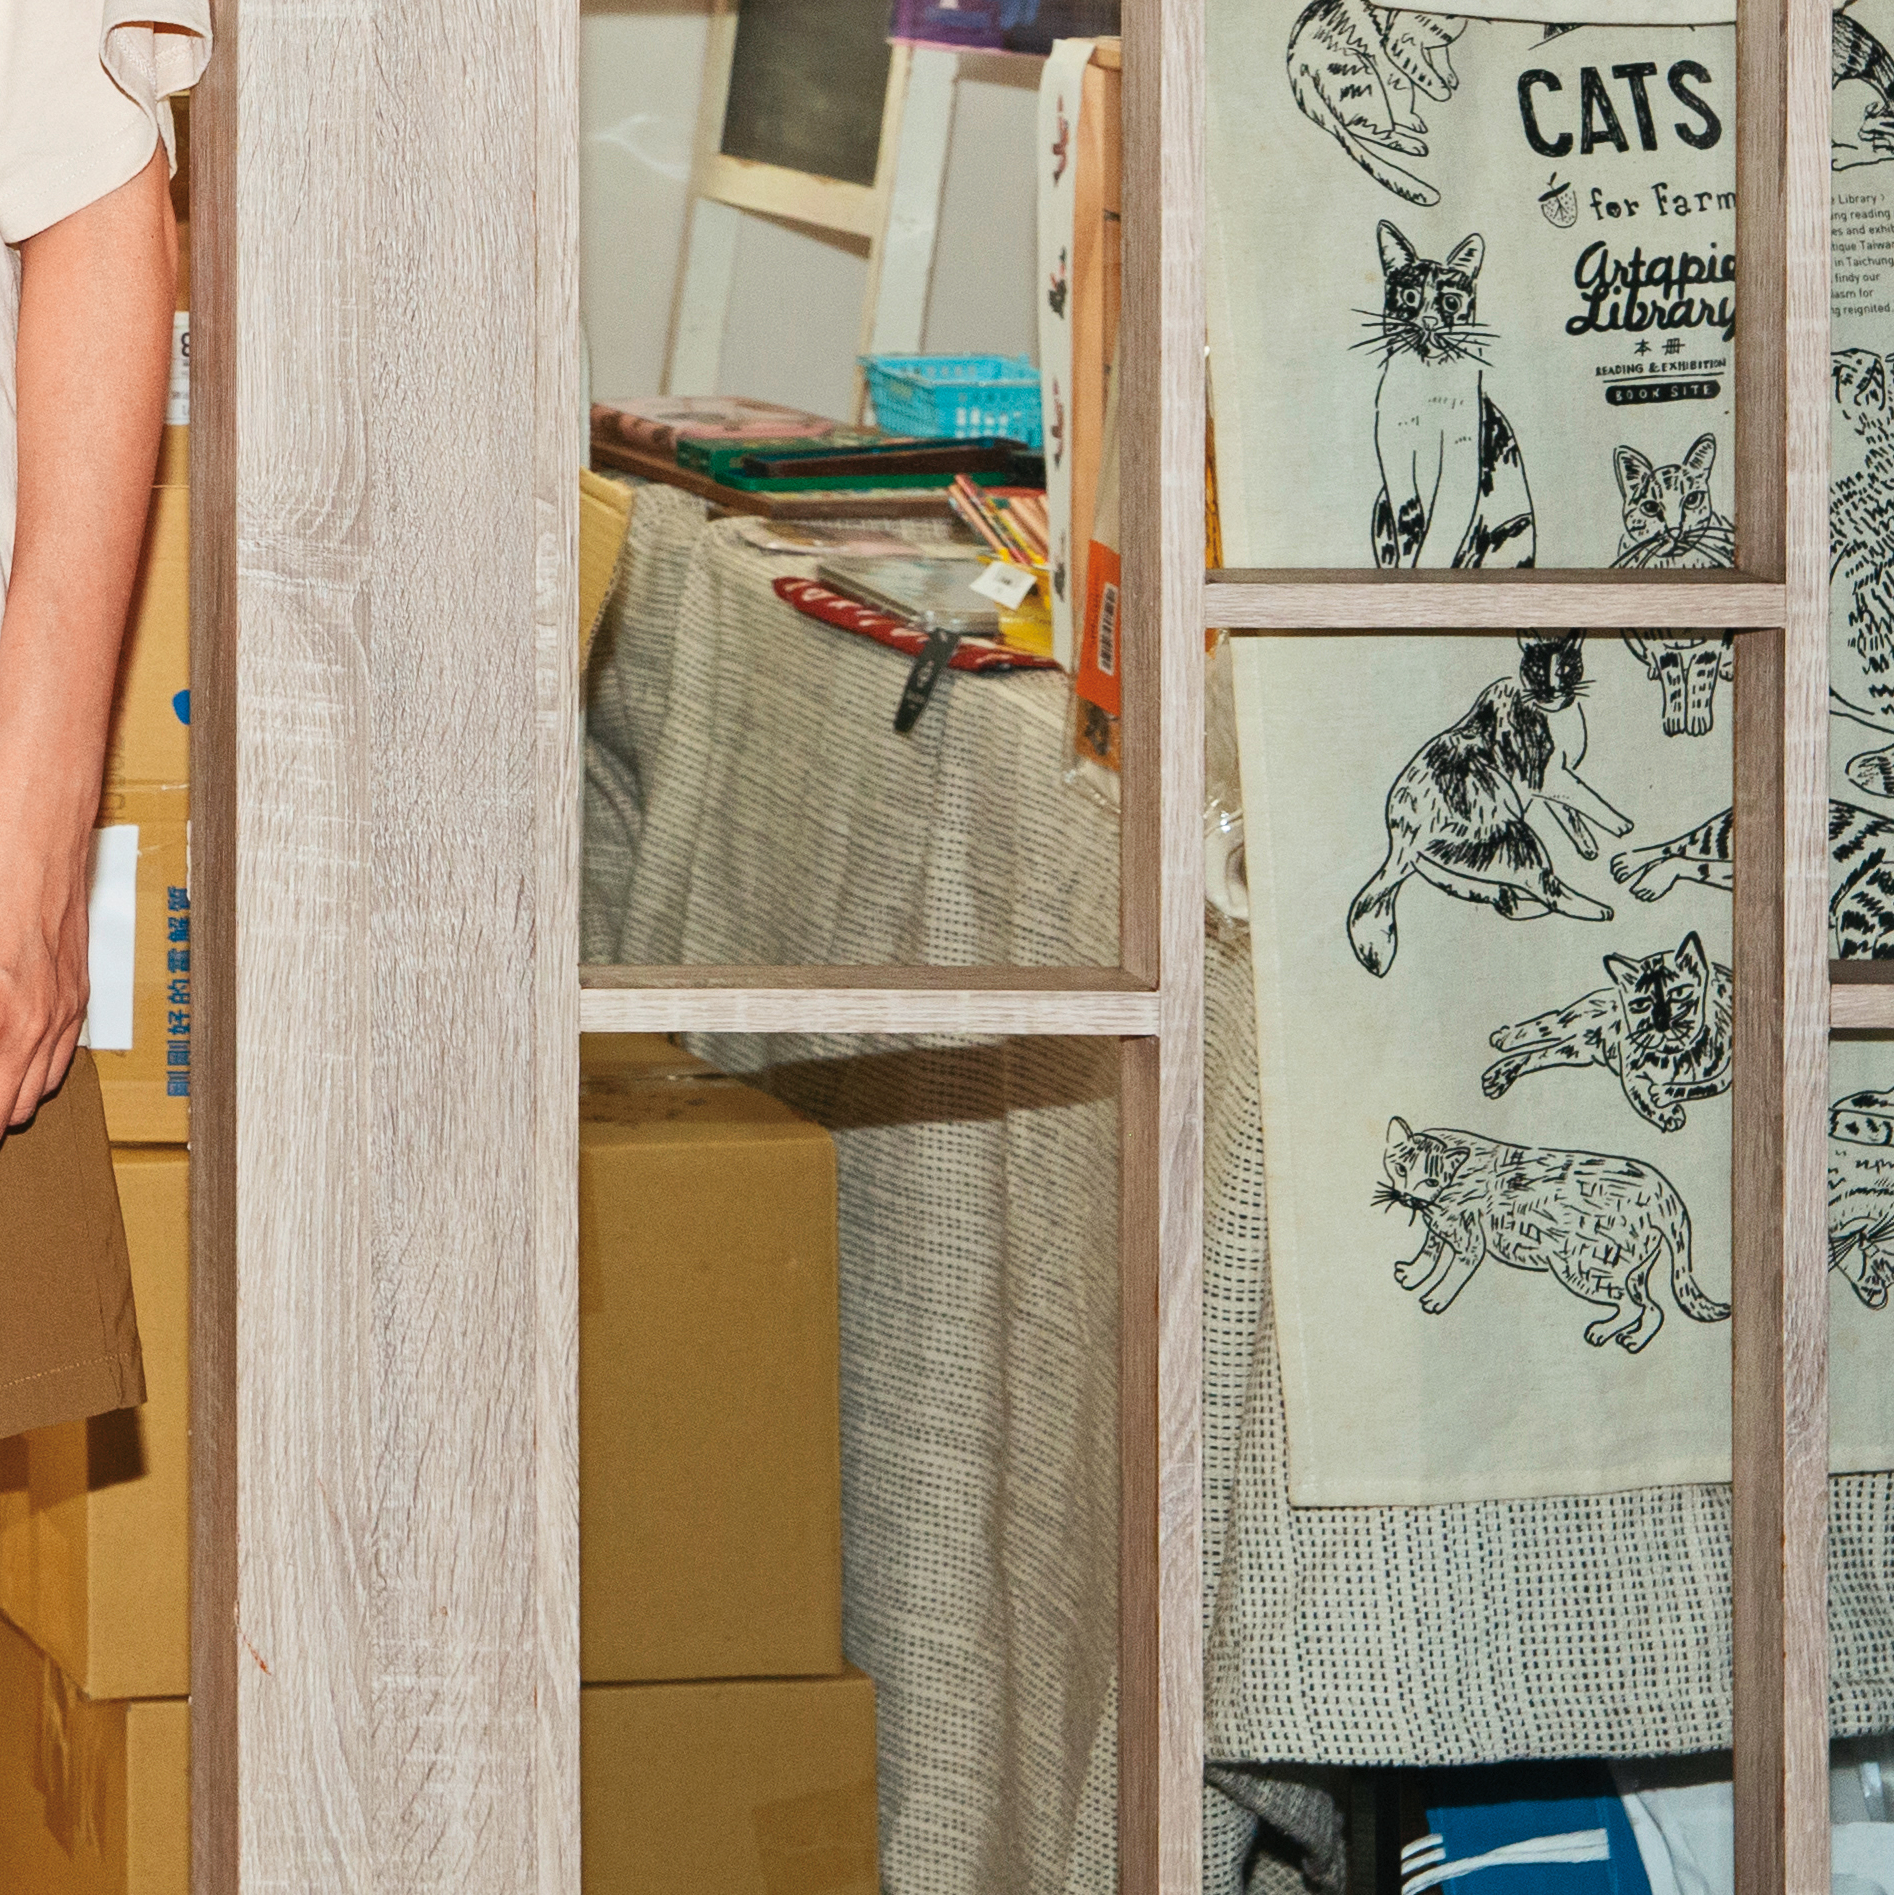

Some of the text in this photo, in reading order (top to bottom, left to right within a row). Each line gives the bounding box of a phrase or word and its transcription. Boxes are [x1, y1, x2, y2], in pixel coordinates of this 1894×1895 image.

[1517, 59, 1723, 158] CATS
[1589, 187, 1639, 220] for
[1846, 225, 1866, 235] and
[1565, 285, 1736, 343] Library
[1595, 363, 1643, 376] READING
[1615, 384, 1711, 401] BOOK SITE
